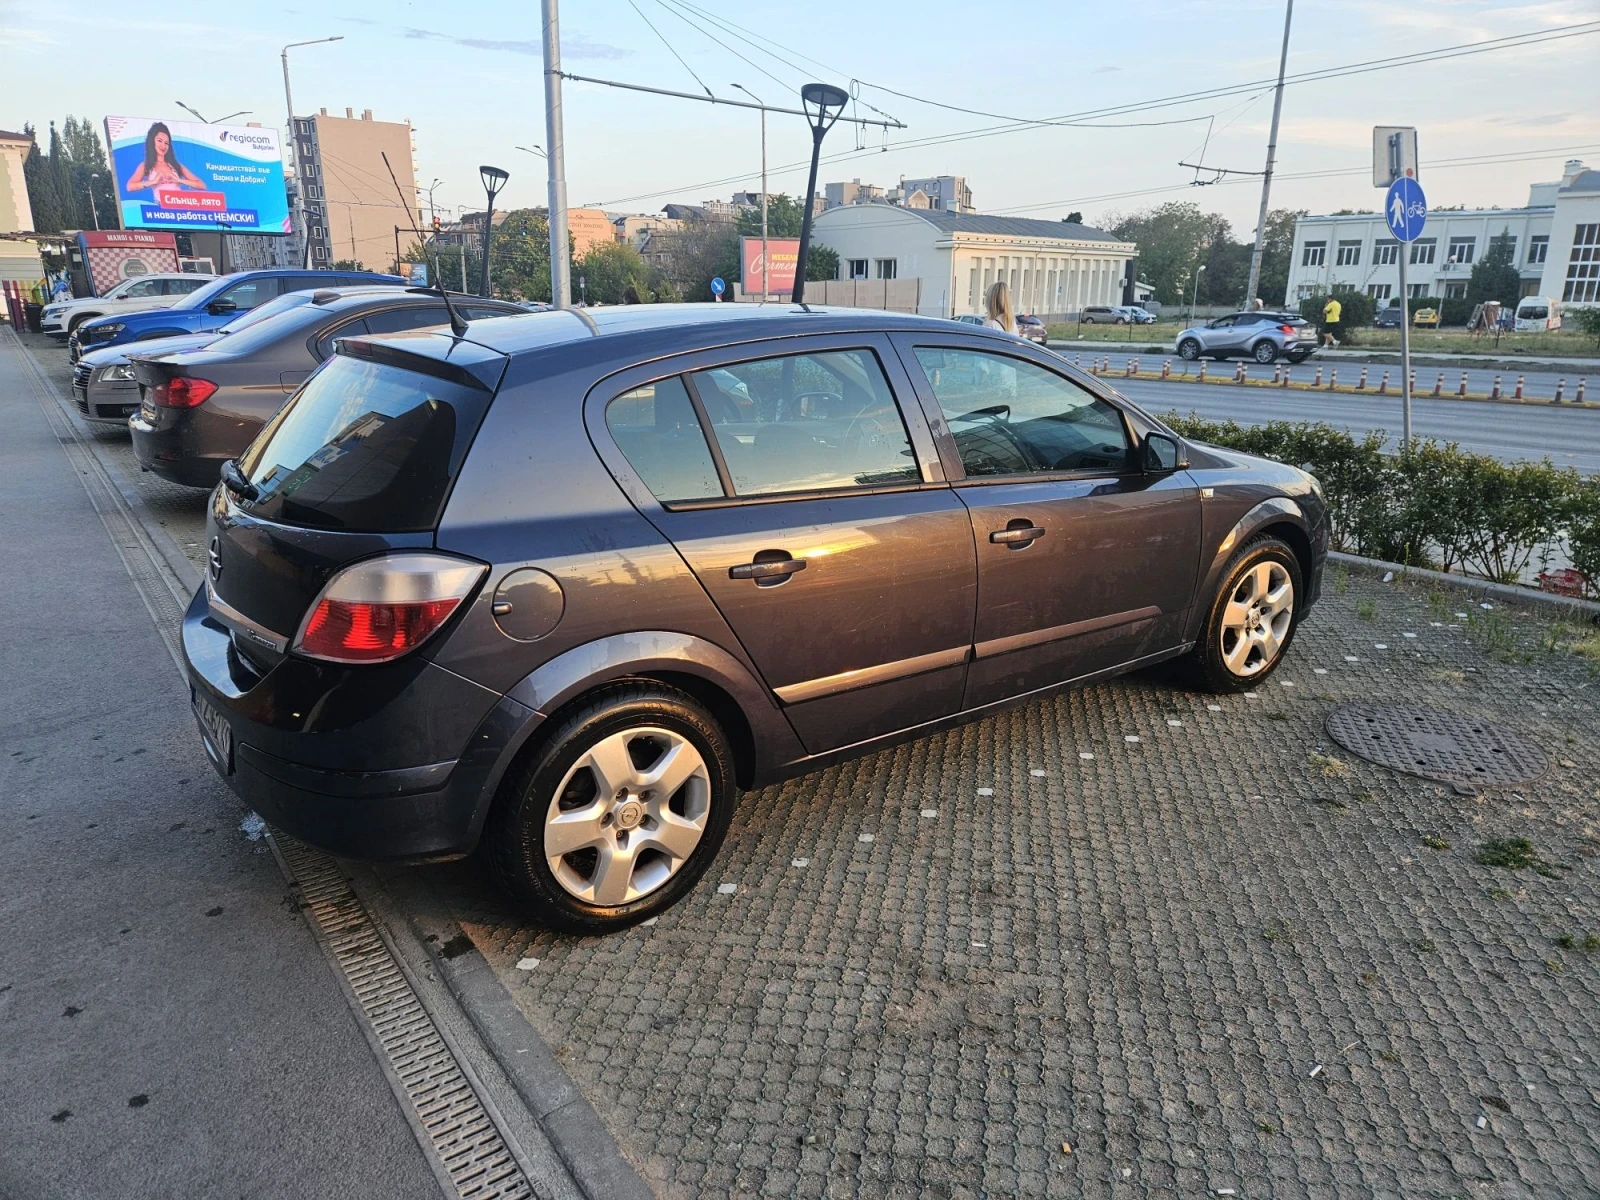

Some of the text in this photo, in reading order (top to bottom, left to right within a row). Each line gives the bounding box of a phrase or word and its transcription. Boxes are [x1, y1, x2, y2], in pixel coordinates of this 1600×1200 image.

[229, 134, 270, 144] regiocom
[205, 162, 257, 173] Кандидатствай
[213, 173, 234, 182] Варна
[164, 194, 200, 206] Слънце,
[146, 211, 153, 219] и
[154, 212, 175, 220] нова
[176, 211, 207, 222] работа
[214, 212, 255, 223] НЕМСКИ!
